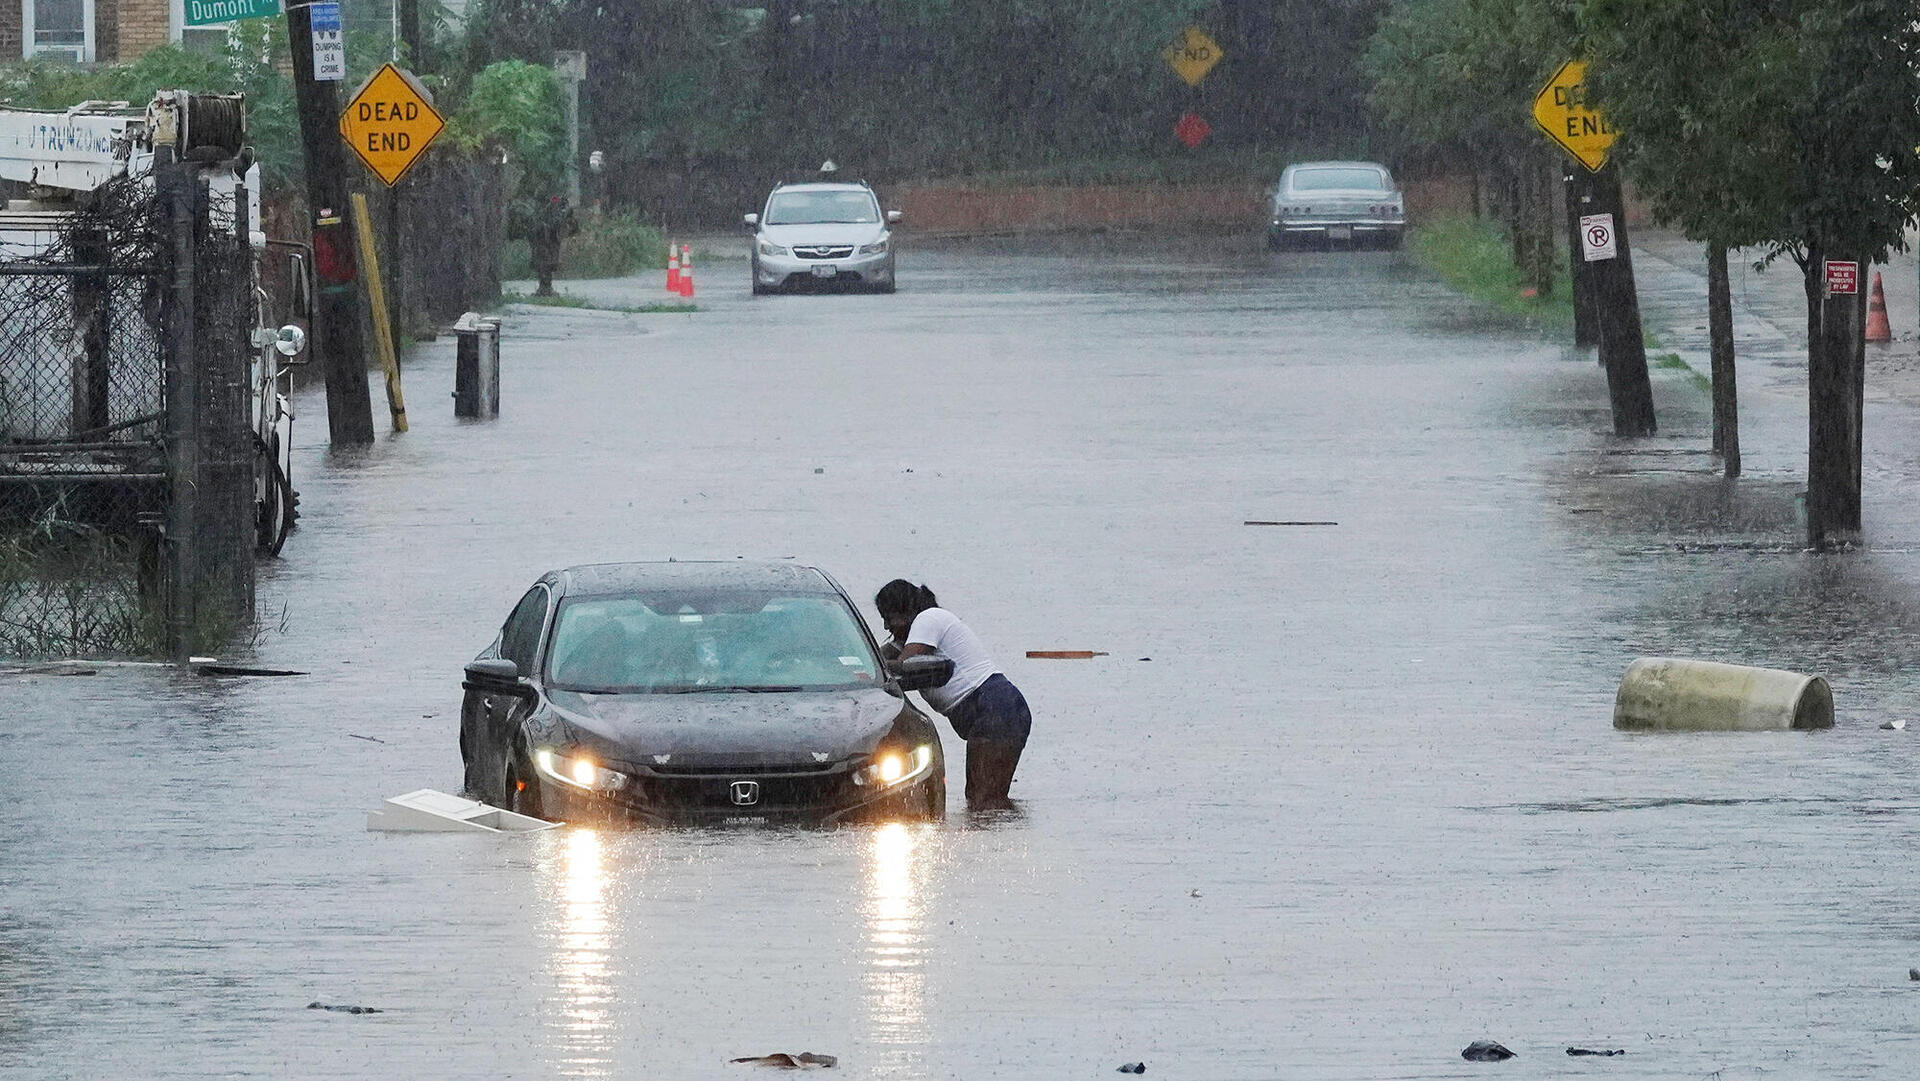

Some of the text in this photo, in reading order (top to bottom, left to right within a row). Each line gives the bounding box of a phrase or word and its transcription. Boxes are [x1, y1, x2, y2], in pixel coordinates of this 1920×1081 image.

[192, 0, 256, 20] Dumont
[315, 42, 342, 51] DUMPING
[321, 65, 339, 73] CRIME
[359, 102, 418, 121] DEAD
[368, 132, 411, 152] END
